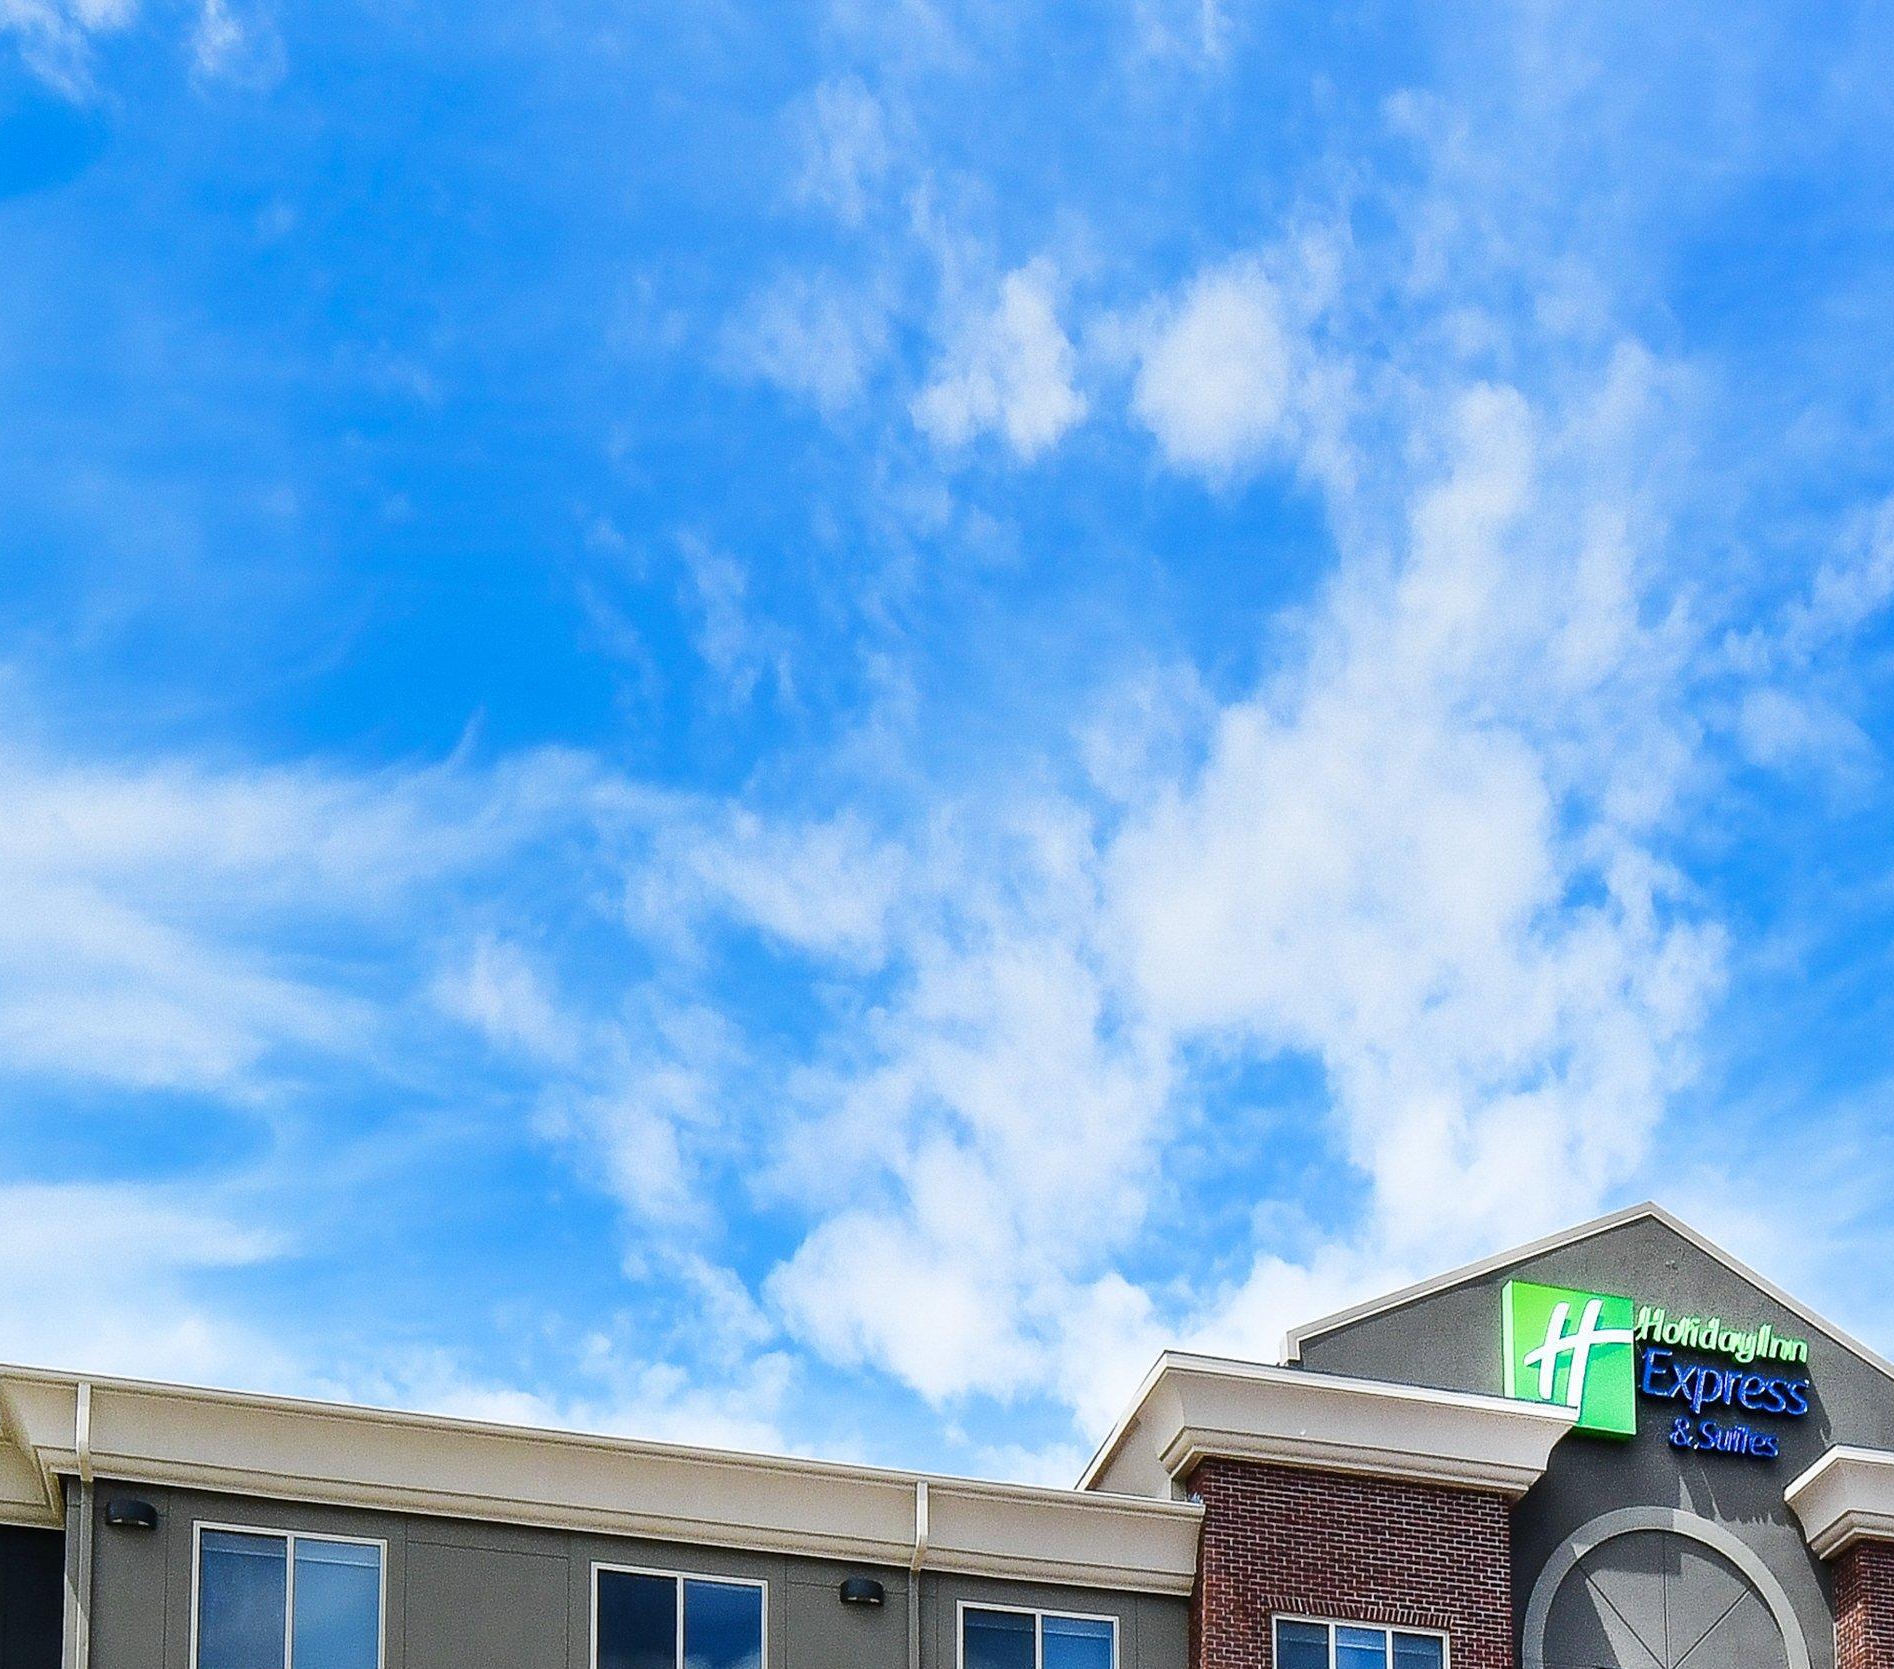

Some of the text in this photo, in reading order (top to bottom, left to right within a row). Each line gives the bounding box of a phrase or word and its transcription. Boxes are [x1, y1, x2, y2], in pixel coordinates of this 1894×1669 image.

[1635, 1305, 1809, 1364] Holiday Inn
[1643, 1346, 1810, 1417] Express
[1669, 1414, 1780, 1459] & Suites
